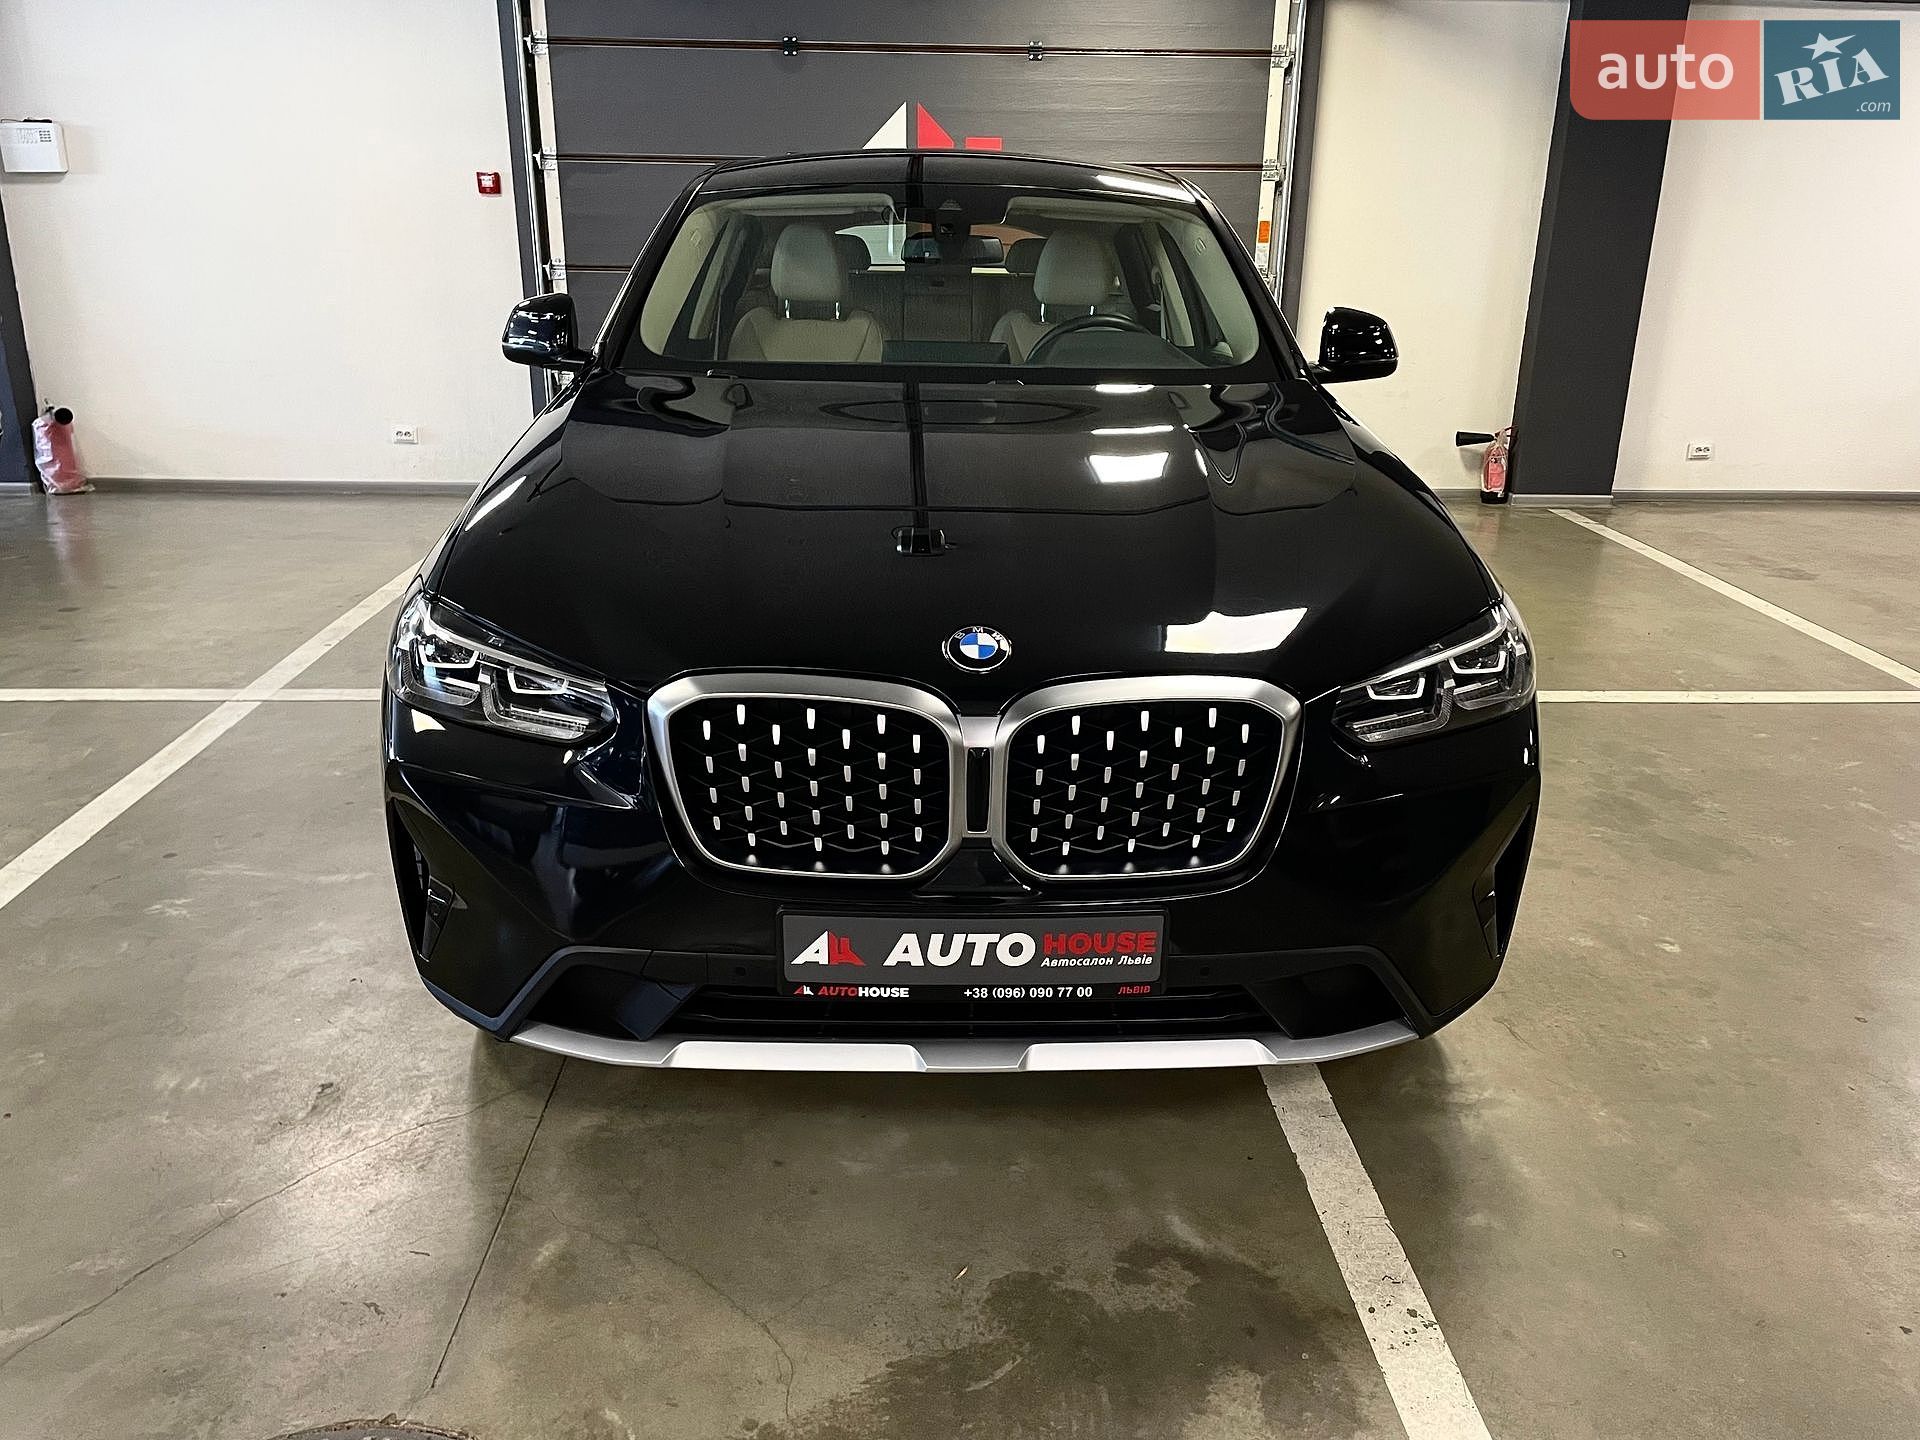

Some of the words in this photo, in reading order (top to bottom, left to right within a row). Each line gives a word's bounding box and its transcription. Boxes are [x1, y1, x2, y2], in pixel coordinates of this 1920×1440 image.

[882, 932, 1037, 968] AUTO
[1043, 931, 1157, 955] HOUSE
[1040, 957, 1114, 968] Автосалон
[1117, 954, 1153, 966] Львів
[963, 987, 989, 999] +38
[992, 987, 1026, 999] (096)
[1029, 987, 1054, 998] 090
[1057, 987, 1073, 998] 77
[1076, 986, 1093, 998] 00
